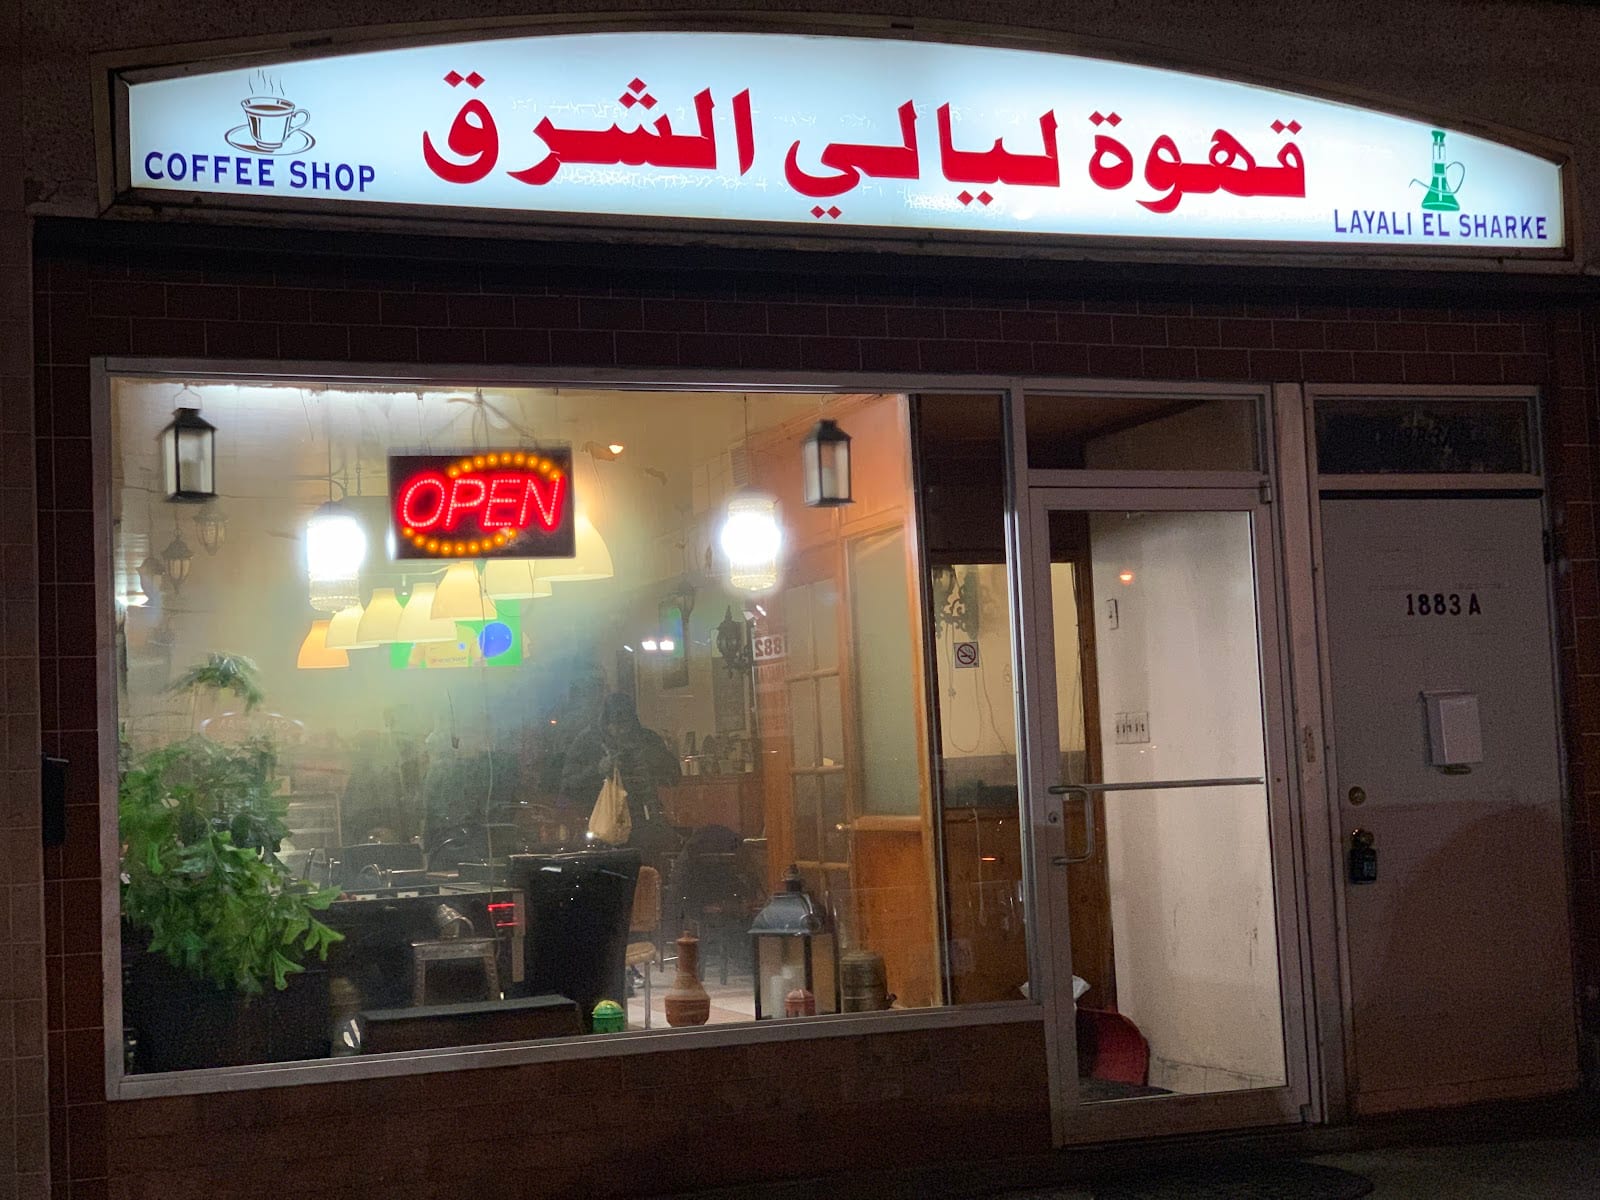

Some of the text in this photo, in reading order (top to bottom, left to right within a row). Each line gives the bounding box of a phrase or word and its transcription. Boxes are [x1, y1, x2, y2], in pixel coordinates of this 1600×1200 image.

[423, 71, 1306, 218] قهوة ليالي الشرق
[145, 152, 375, 193] COFFEE SHOP
[1335, 210, 1548, 240] LAYALI EL SHARKE
[399, 472, 565, 531] OPEN
